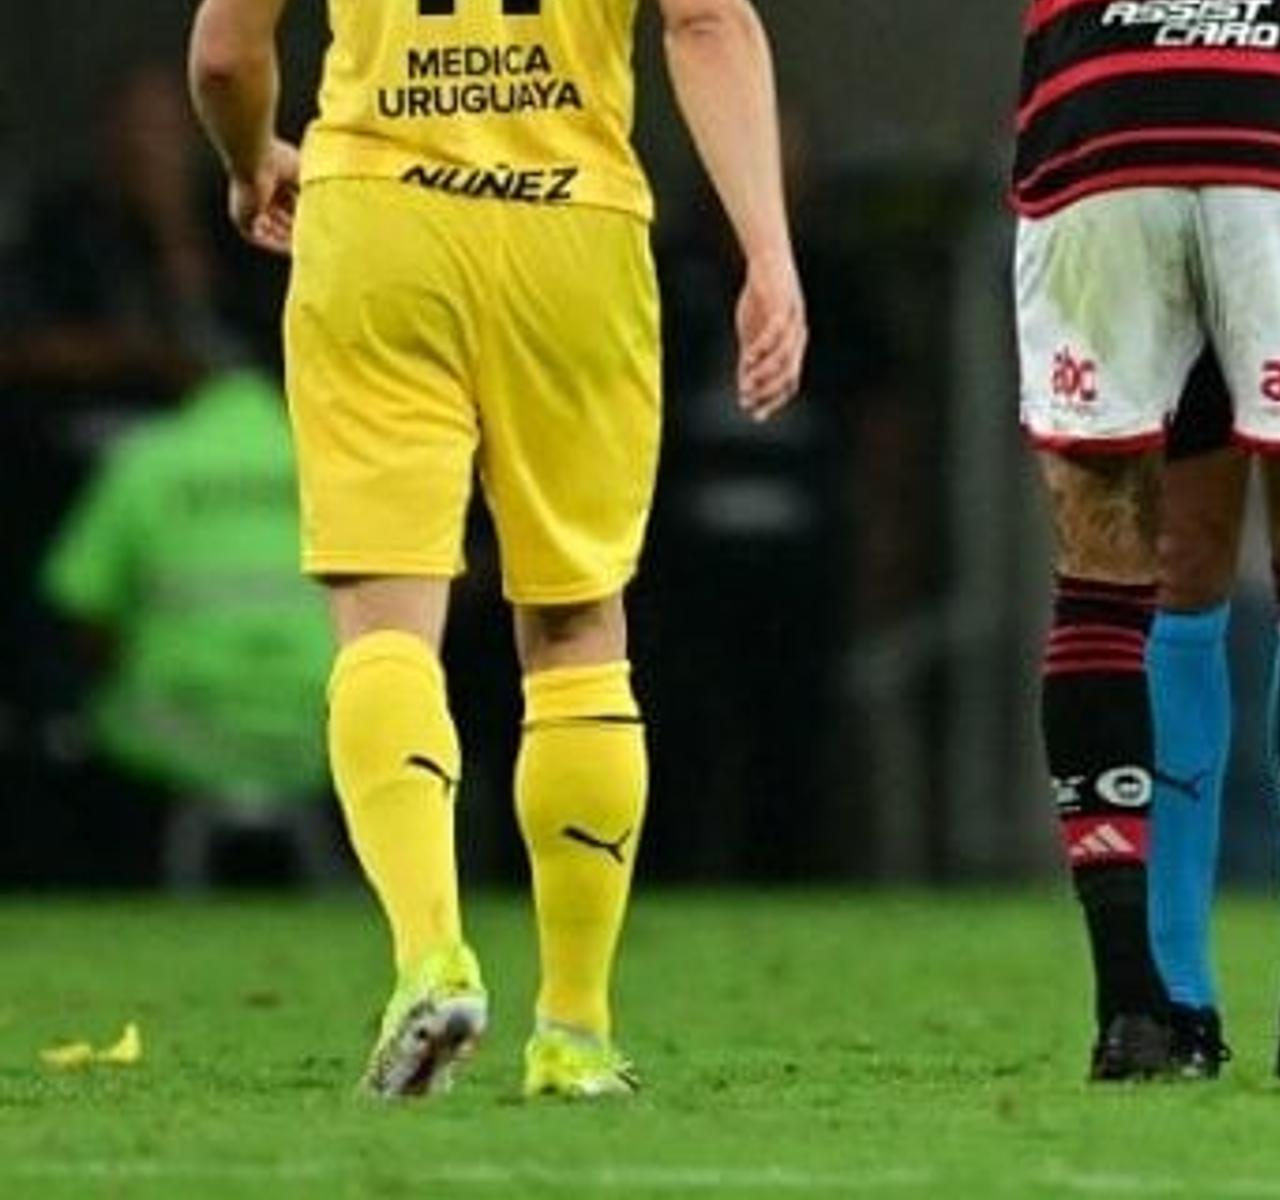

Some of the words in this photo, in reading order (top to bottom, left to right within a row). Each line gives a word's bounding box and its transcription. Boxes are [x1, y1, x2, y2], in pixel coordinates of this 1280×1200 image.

[1153, 21, 1280, 48] CARD
[407, 44, 551, 79] MEDICA
[378, 80, 584, 118] URUGUAYA
